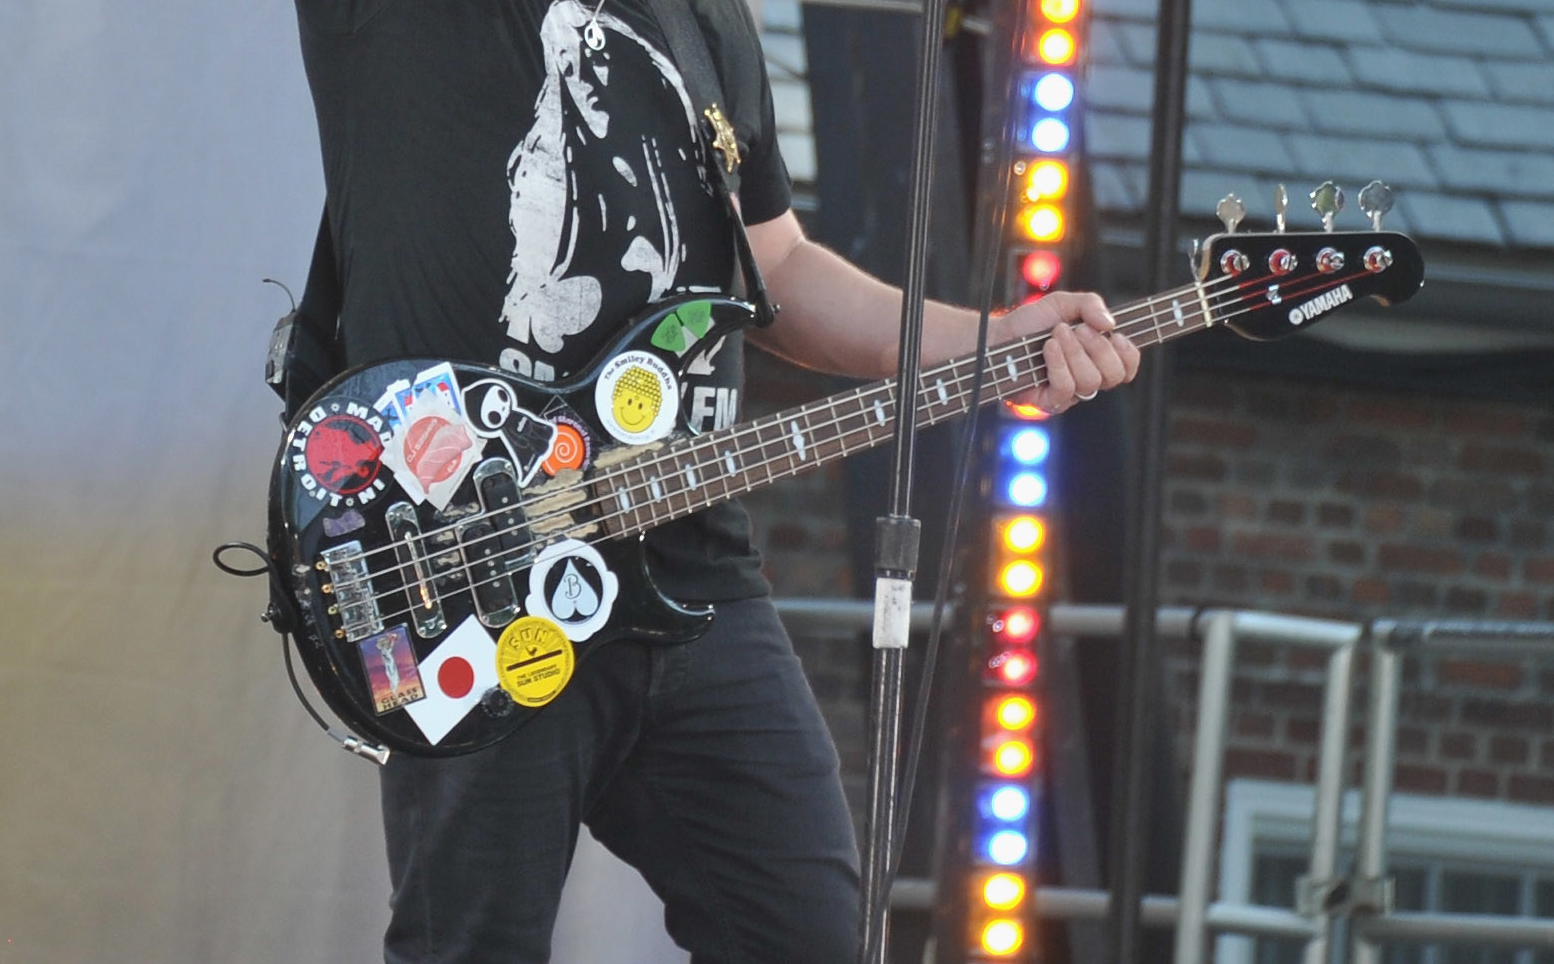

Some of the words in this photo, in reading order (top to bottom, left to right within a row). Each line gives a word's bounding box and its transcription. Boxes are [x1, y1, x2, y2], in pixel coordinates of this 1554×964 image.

[1301, 284, 1353, 320] YAMAHA
[604, 368, 615, 380] The
[614, 355, 645, 369] Smiley
[647, 358, 672, 390] Buddha
[346, 402, 393, 445] MAD
[293, 406, 343, 507] DETROIT
[563, 573, 582, 599] B
[509, 627, 548, 649] SUN
[381, 687, 418, 704] GLASS
[383, 694, 419, 711] HEAD
